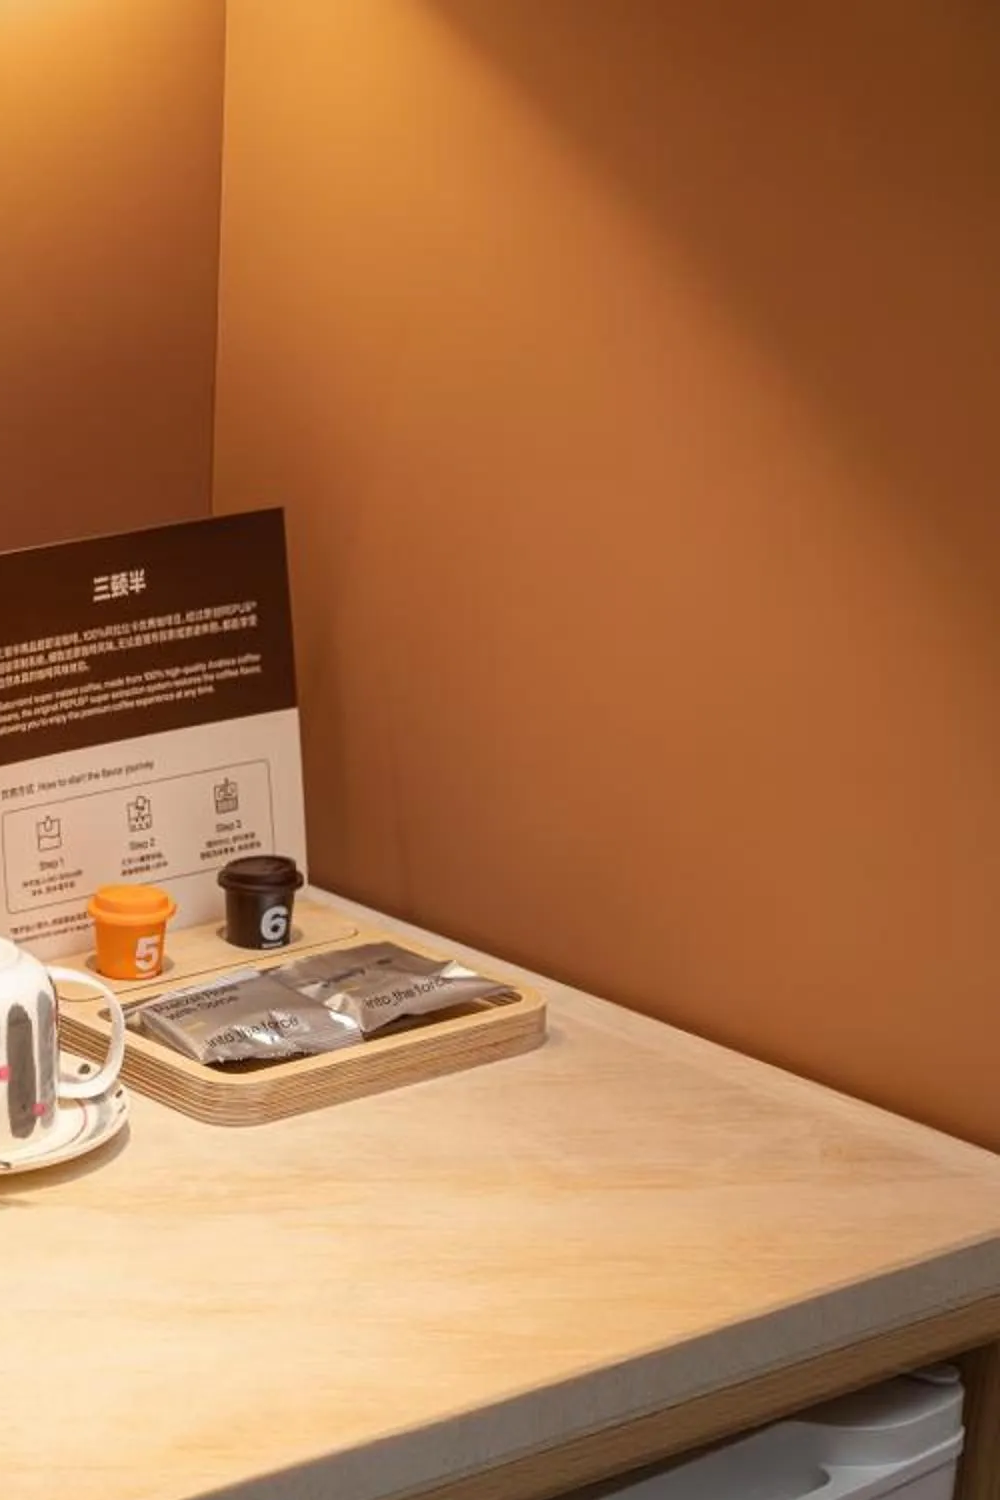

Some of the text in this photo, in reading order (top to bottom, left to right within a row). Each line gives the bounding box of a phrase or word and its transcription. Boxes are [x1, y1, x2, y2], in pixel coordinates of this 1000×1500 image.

[92, 567, 146, 601] 三顿半
[261, 905, 288, 941] 6
[136, 935, 160, 973] 5
